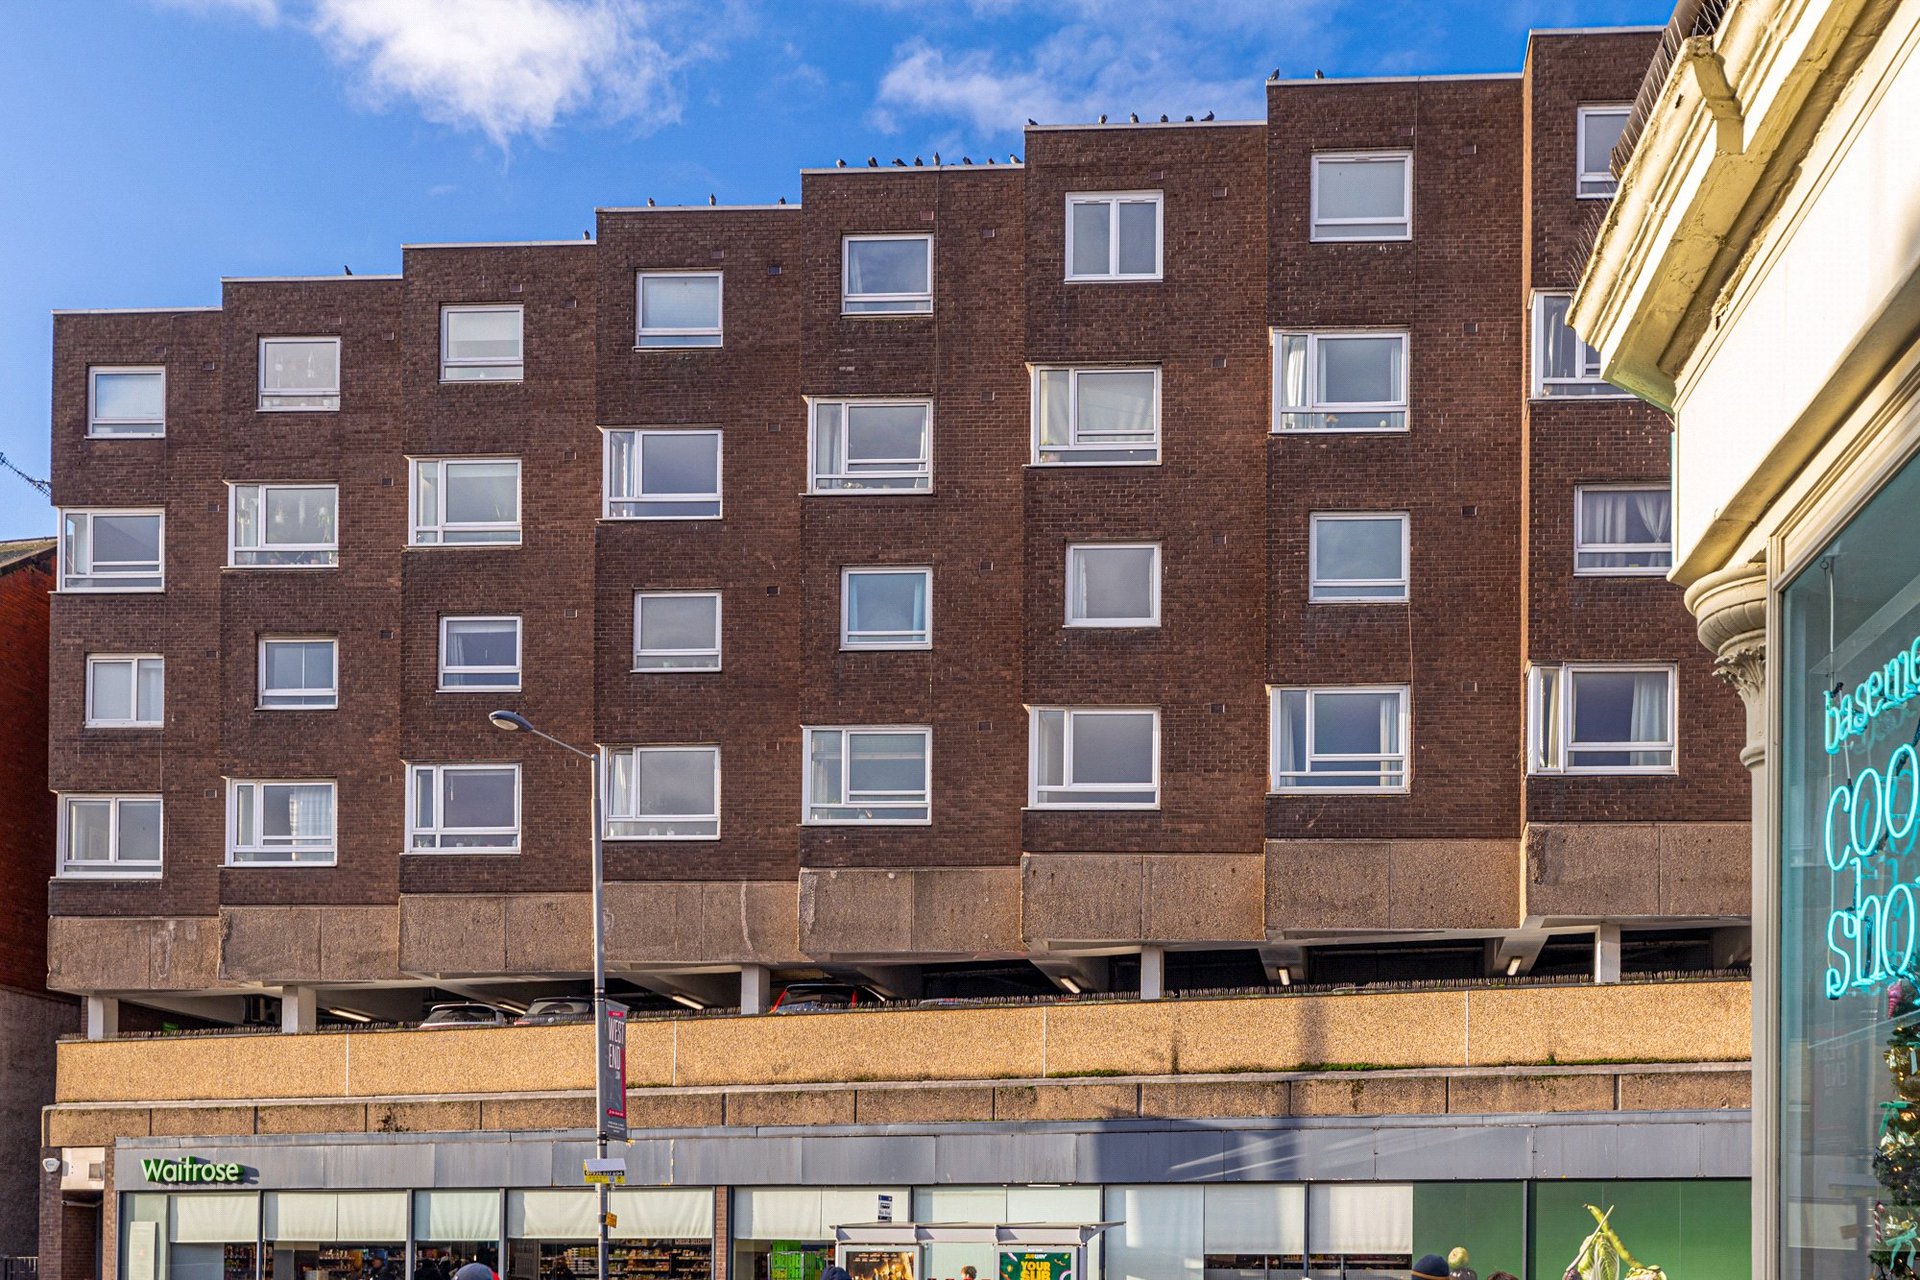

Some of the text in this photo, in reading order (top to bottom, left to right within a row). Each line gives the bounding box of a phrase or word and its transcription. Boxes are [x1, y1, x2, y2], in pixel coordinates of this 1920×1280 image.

[1825, 856, 1920, 1000] sho
[608, 1017, 625, 1044] WEST
[608, 1043, 621, 1070] END
[139, 1155, 241, 1183] Waitrose
[1020, 1261, 1051, 1271] YOUR
[1020, 1270, 1051, 1280] SUB
